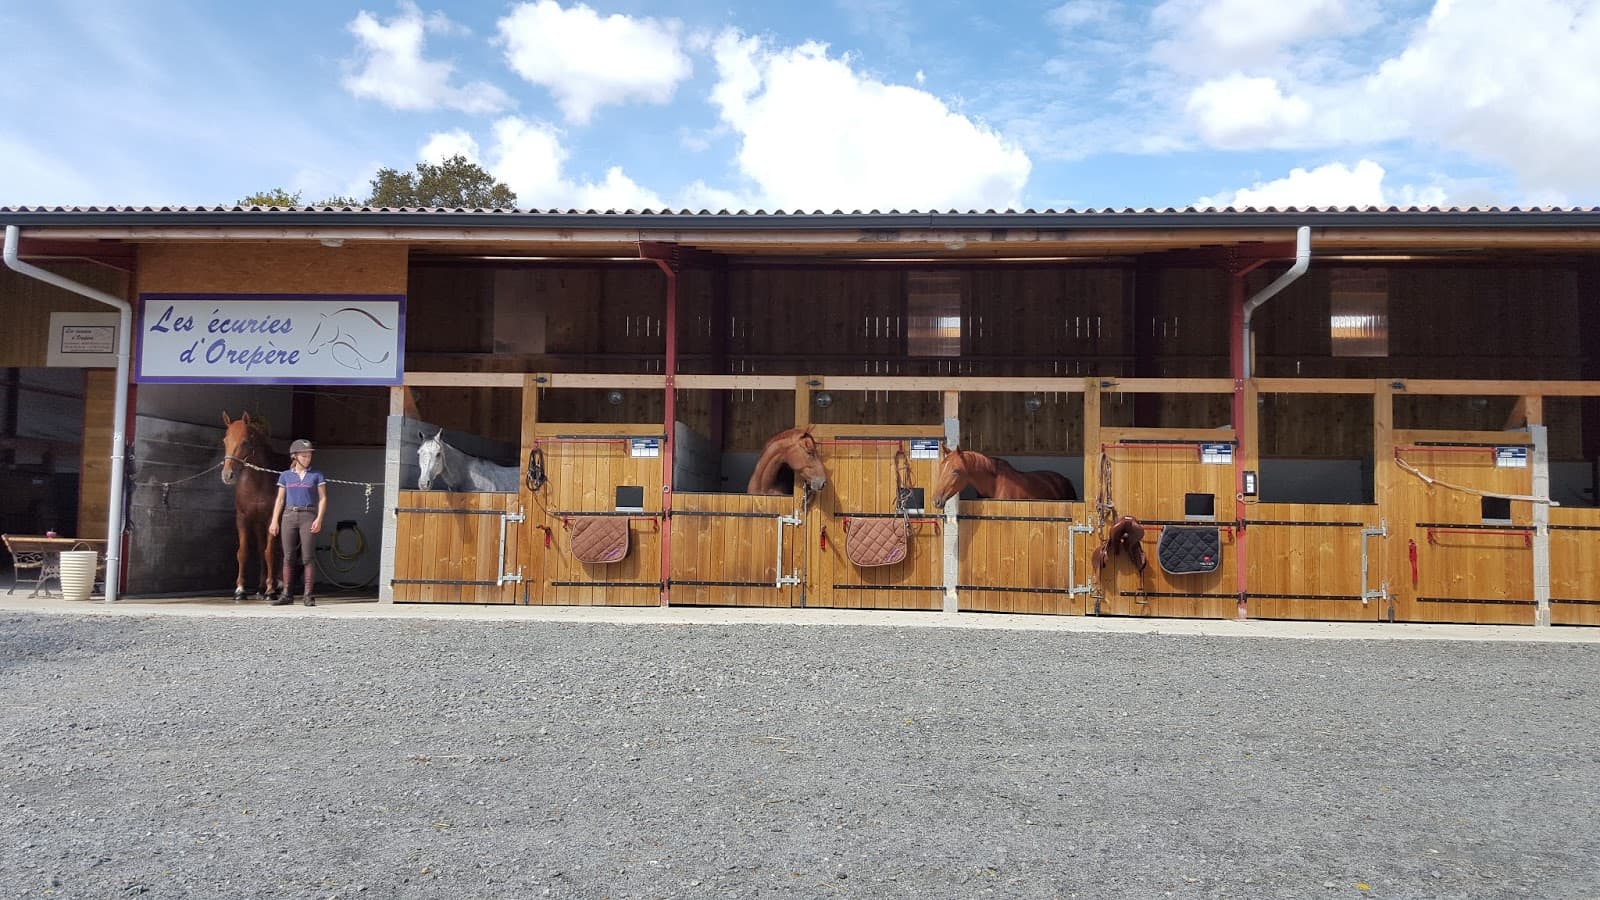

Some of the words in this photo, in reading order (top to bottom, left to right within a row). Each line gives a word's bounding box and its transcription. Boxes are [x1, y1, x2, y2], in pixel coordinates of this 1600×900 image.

[150, 305, 194, 333] Les
[208, 308, 293, 334] écuries
[179, 338, 300, 372] d'Orepère
